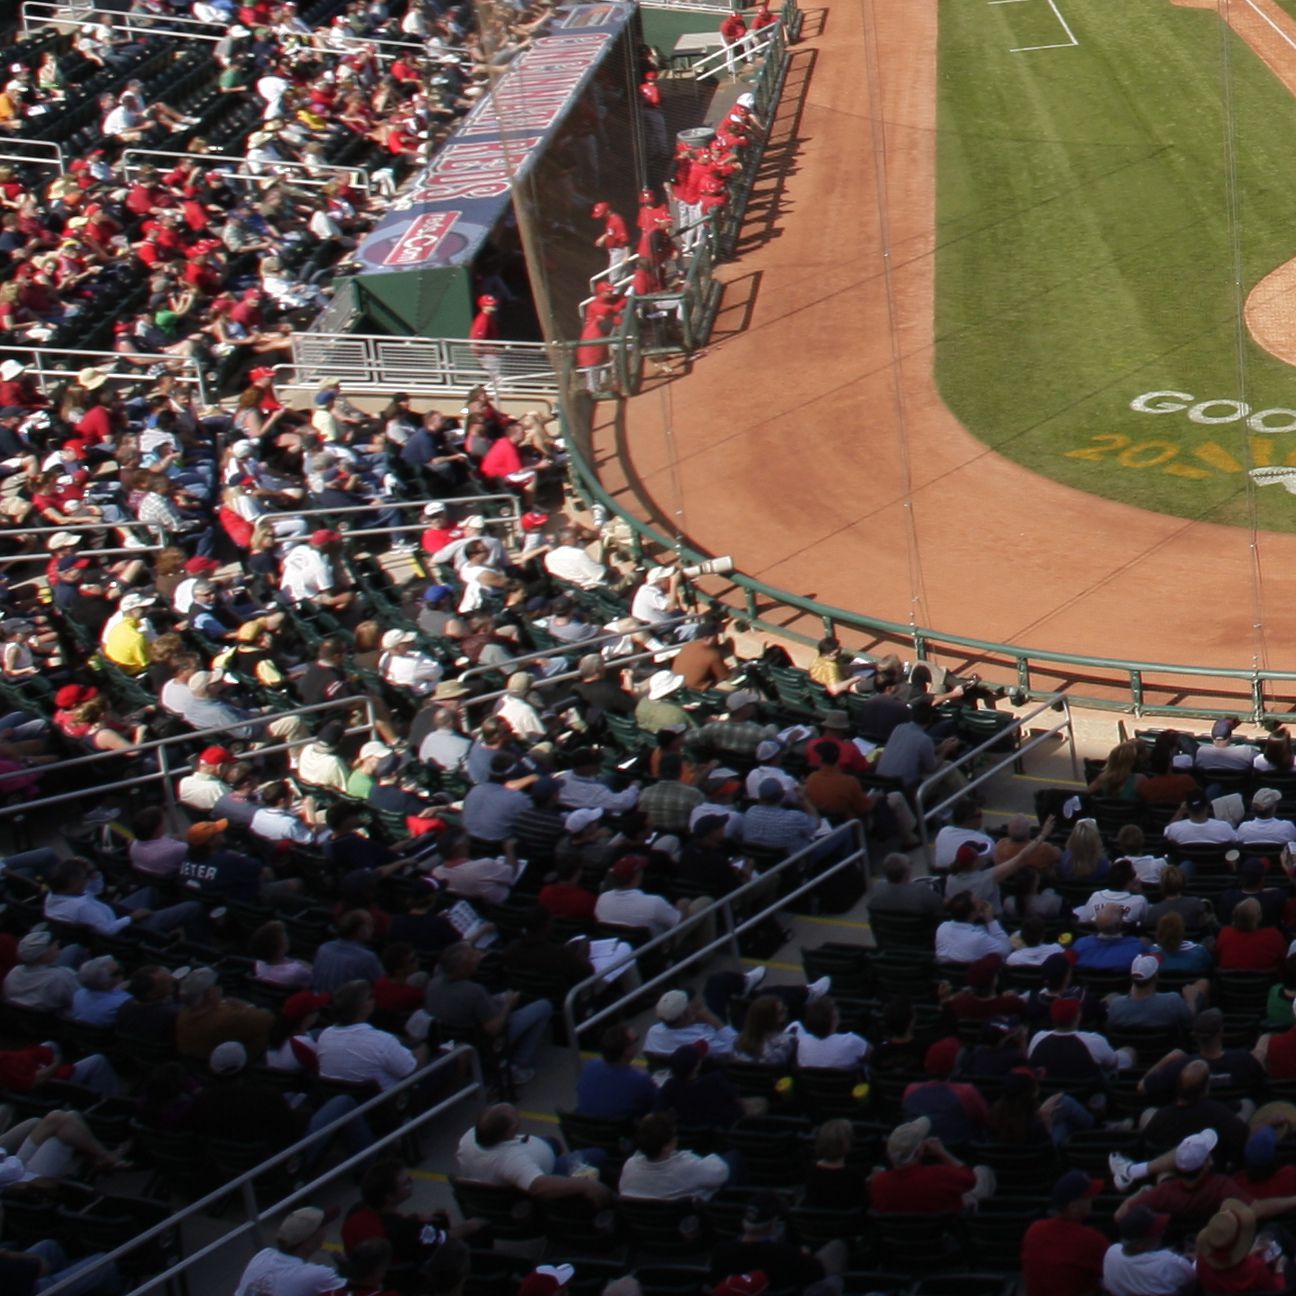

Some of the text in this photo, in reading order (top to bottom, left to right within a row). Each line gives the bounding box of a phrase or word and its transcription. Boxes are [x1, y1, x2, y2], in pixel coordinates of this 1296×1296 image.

[456, 32, 612, 138] CINCINNATI
[414, 135, 544, 202] REDS
[1064, 433, 1182, 468] 20
